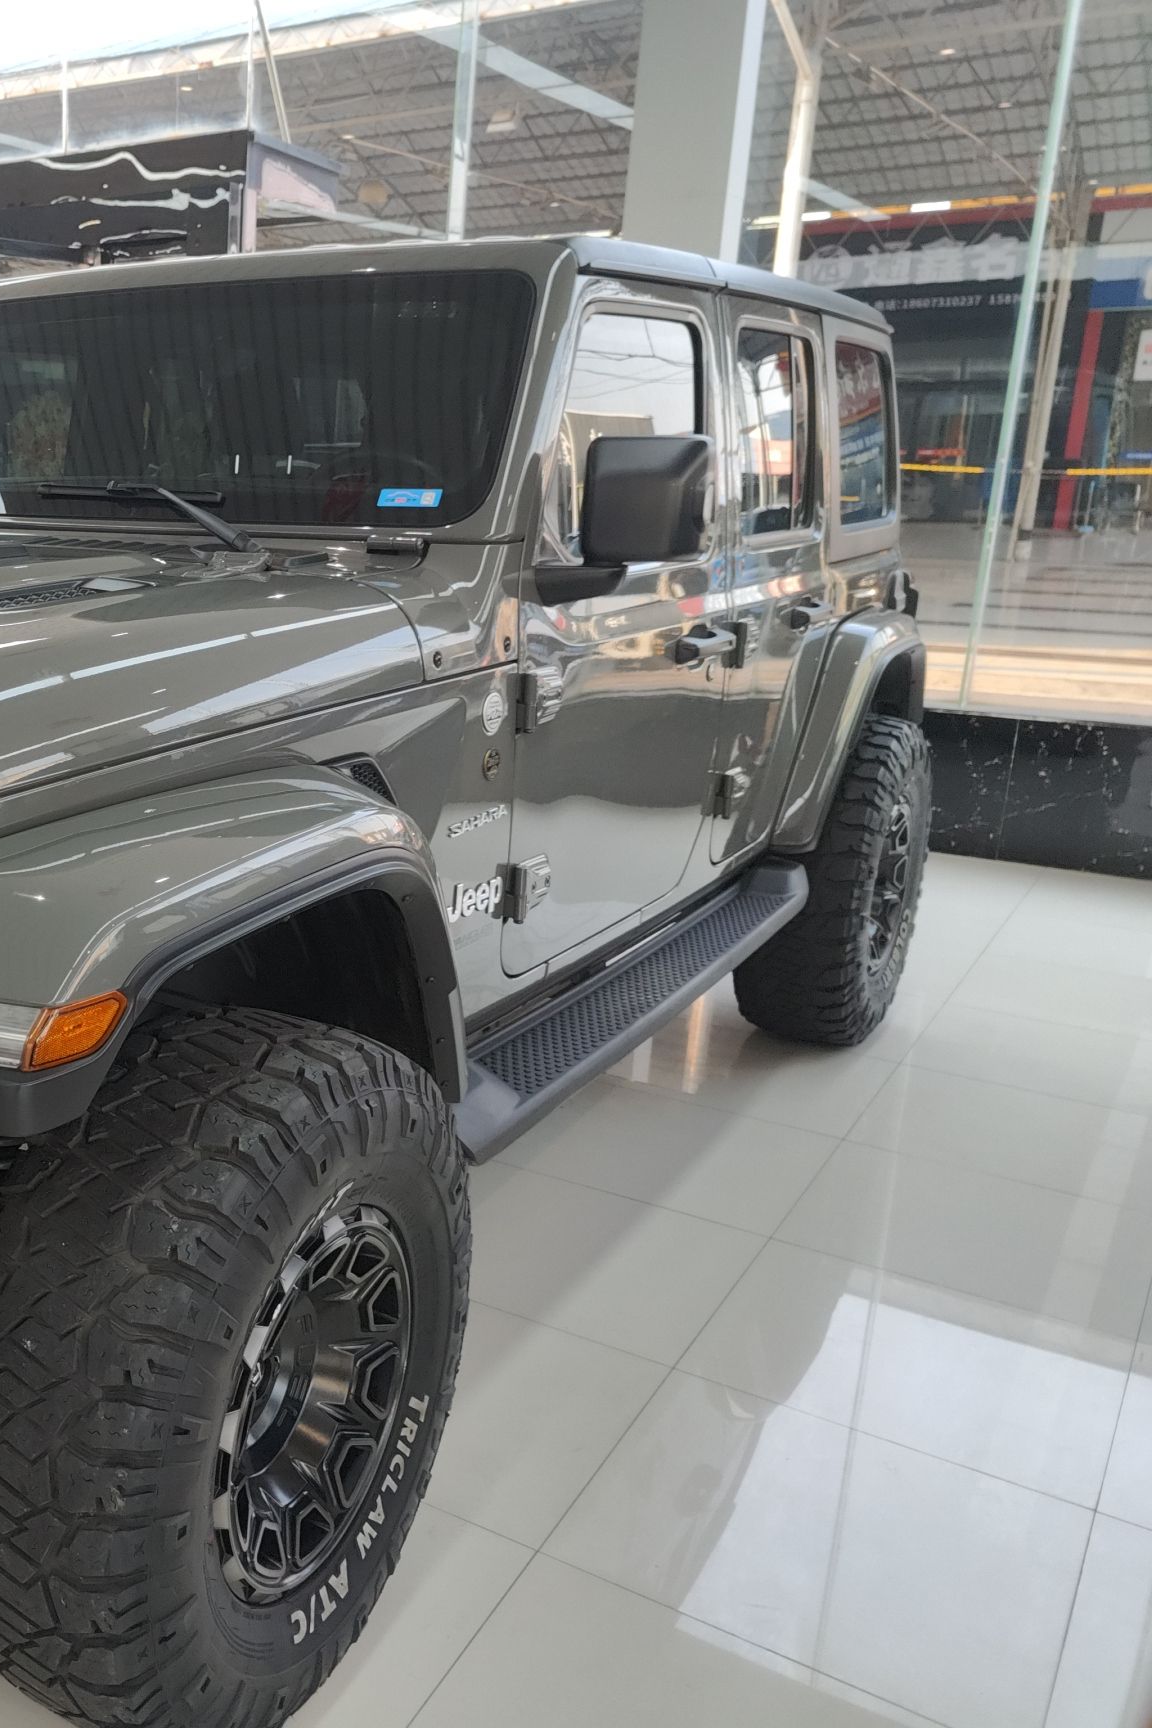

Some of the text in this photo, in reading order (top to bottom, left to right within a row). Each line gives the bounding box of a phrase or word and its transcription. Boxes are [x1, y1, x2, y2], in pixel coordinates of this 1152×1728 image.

[448, 804, 508, 838] SAHARA
[446, 876, 503, 923] Jeep
[290, 1394, 429, 1645] TRICLAW AT/C
